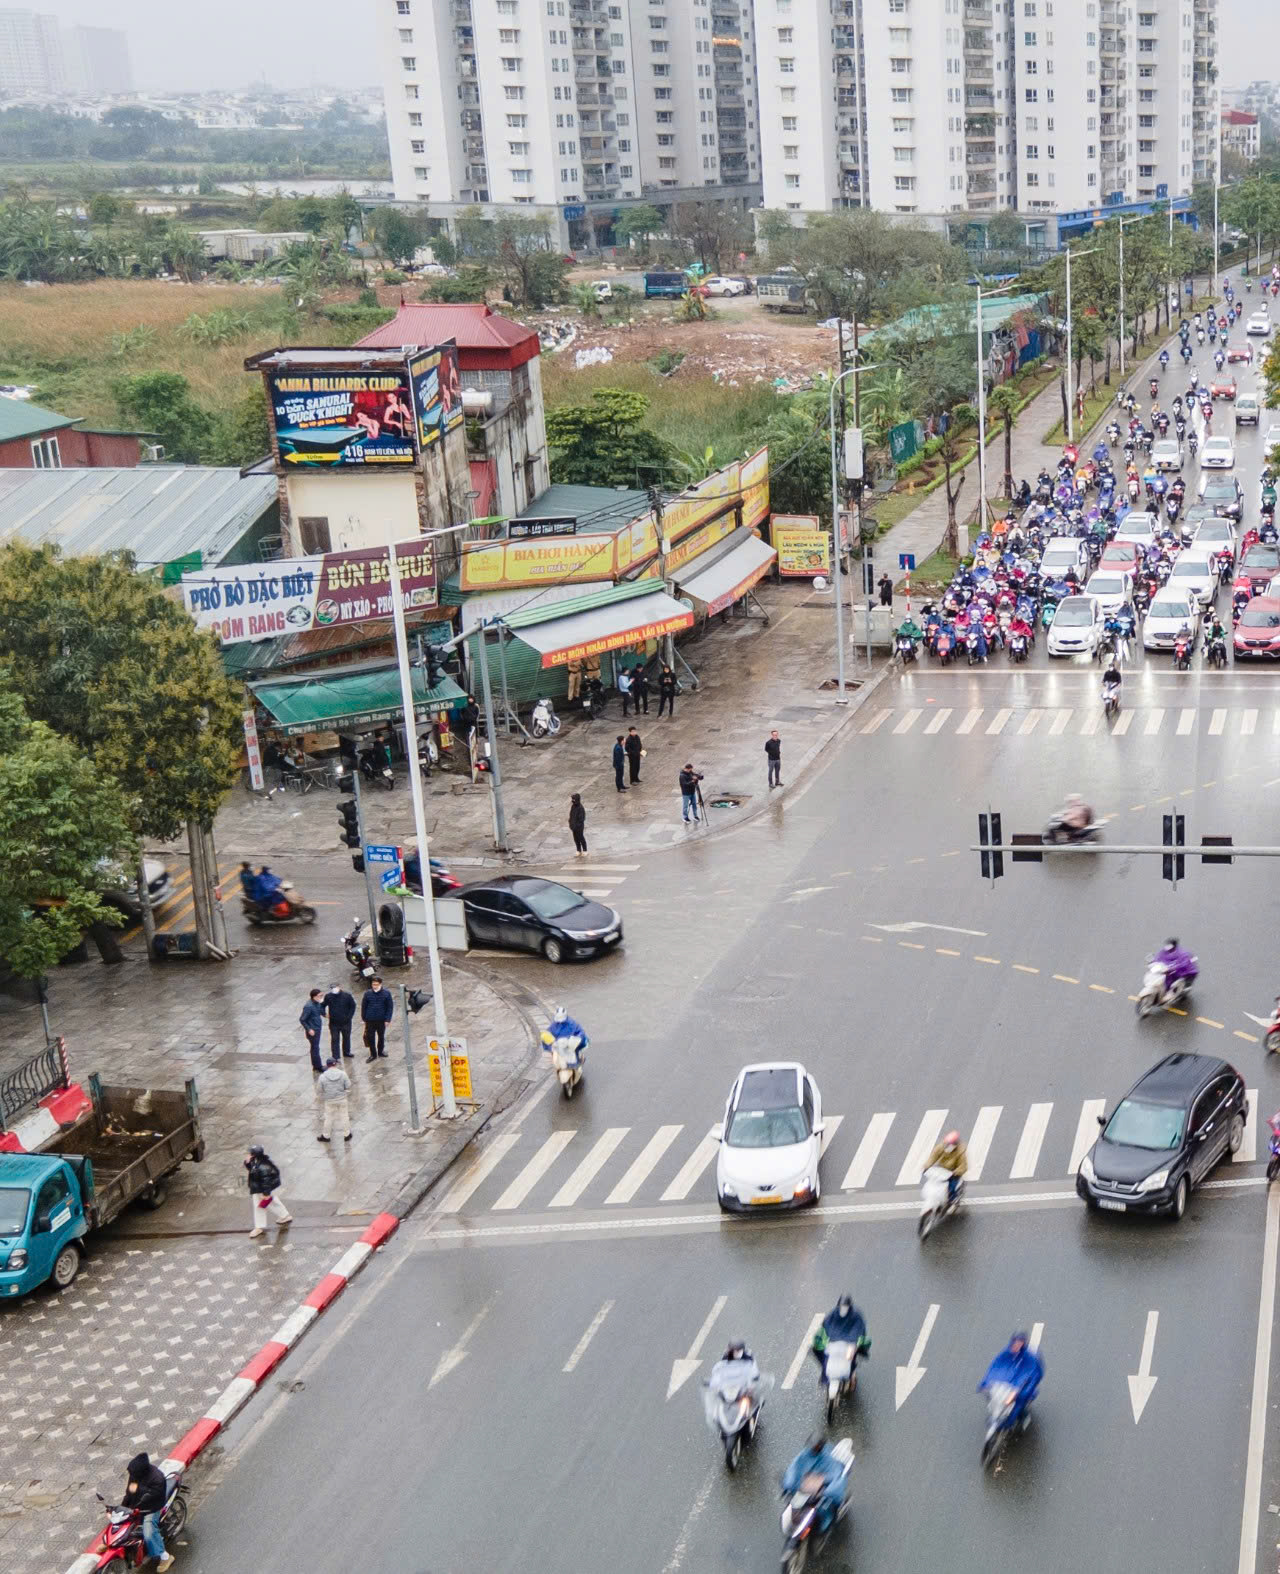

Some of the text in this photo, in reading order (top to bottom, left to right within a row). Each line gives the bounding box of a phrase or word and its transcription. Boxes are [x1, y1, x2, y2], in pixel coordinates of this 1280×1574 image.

[276, 406, 286, 416] 10
[306, 392, 351, 411] SAMURAI
[287, 408, 317, 425] DUCK
[315, 402, 354, 420] KNIGHT
[514, 549, 536, 561] BIA
[327, 559, 366, 592] BÚN
[224, 576, 244, 608] BÒ
[248, 572, 280, 609] ĐẶC
[282, 567, 315, 602] BIỆT
[249, 610, 286, 636] RANG
[551, 651, 567, 665] CÁC
